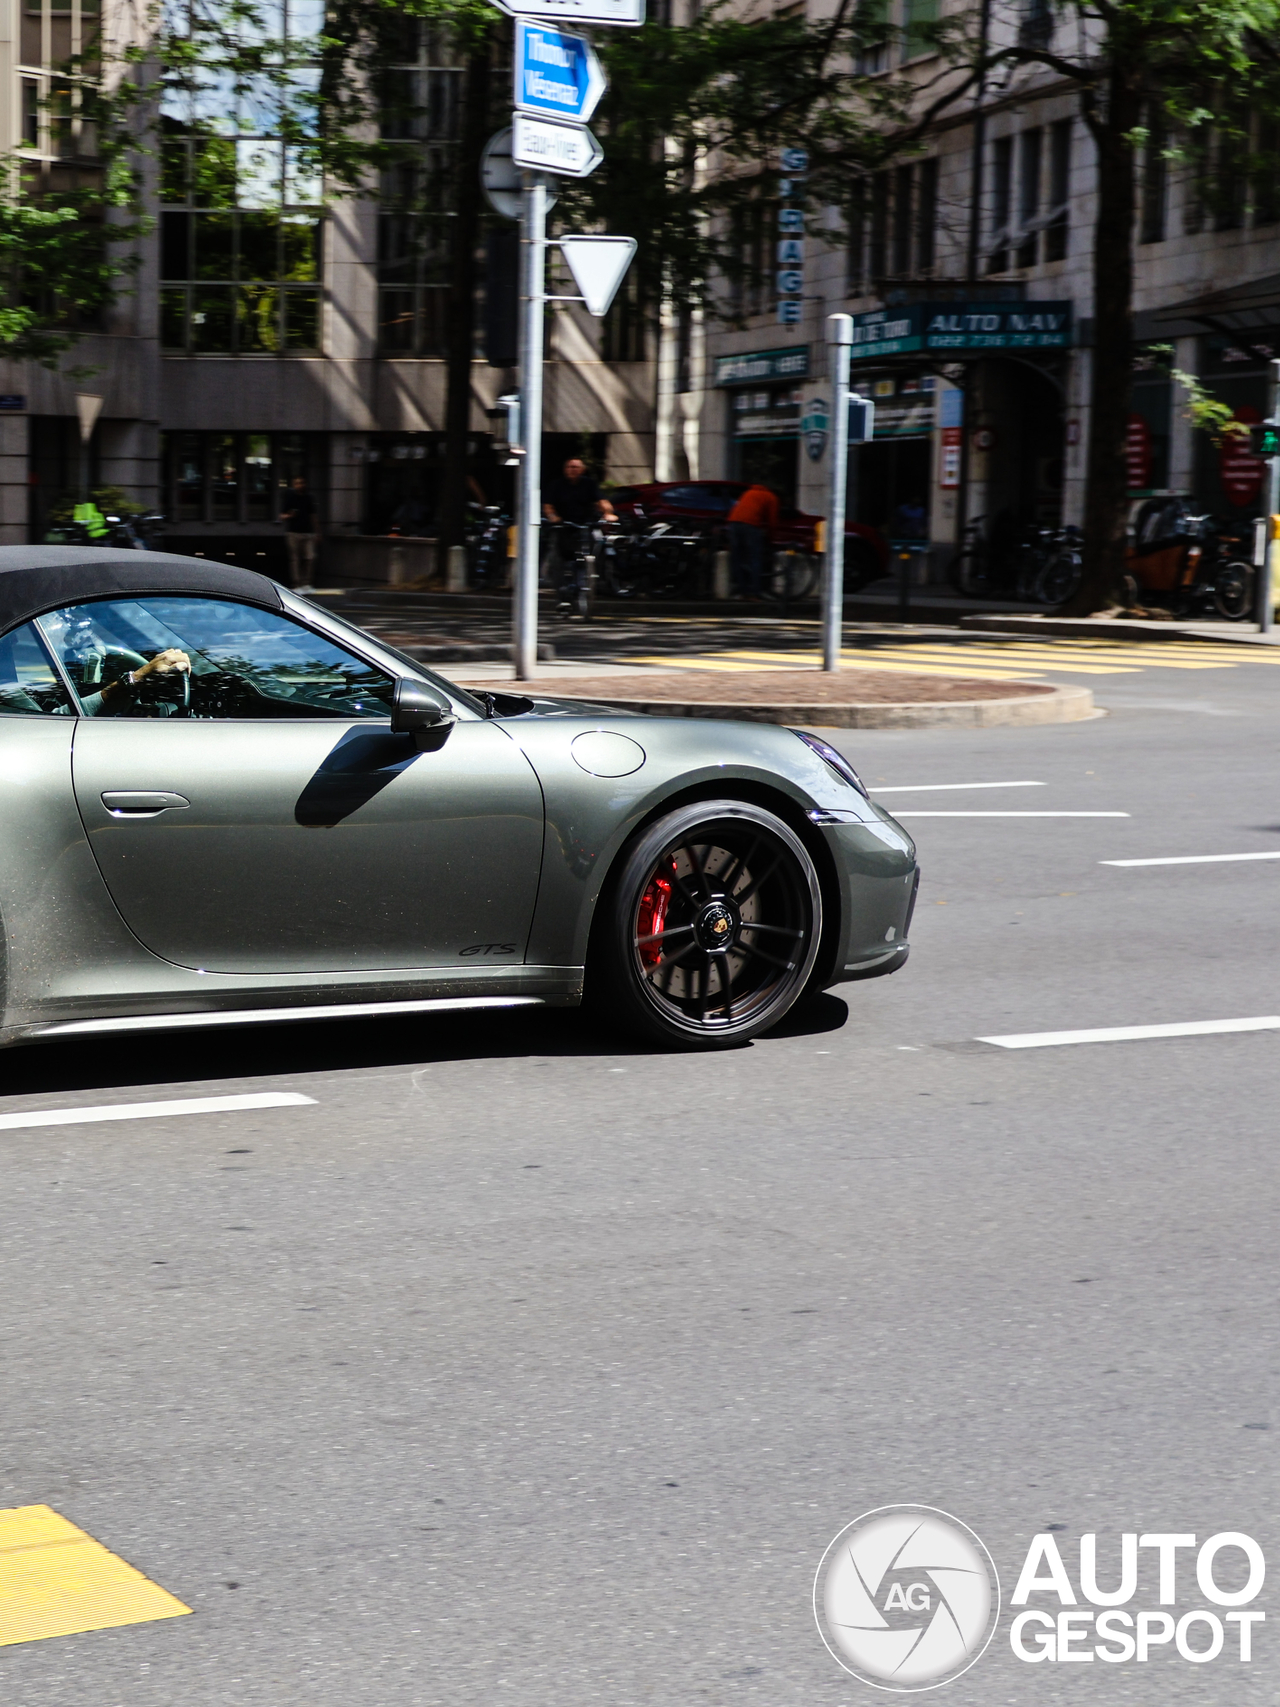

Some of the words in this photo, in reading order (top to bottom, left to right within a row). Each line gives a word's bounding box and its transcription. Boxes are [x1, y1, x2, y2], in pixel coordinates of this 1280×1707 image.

[926, 314, 1002, 331] AUTO
[1006, 314, 1066, 331] NAV
[458, 943, 517, 957] GTS
